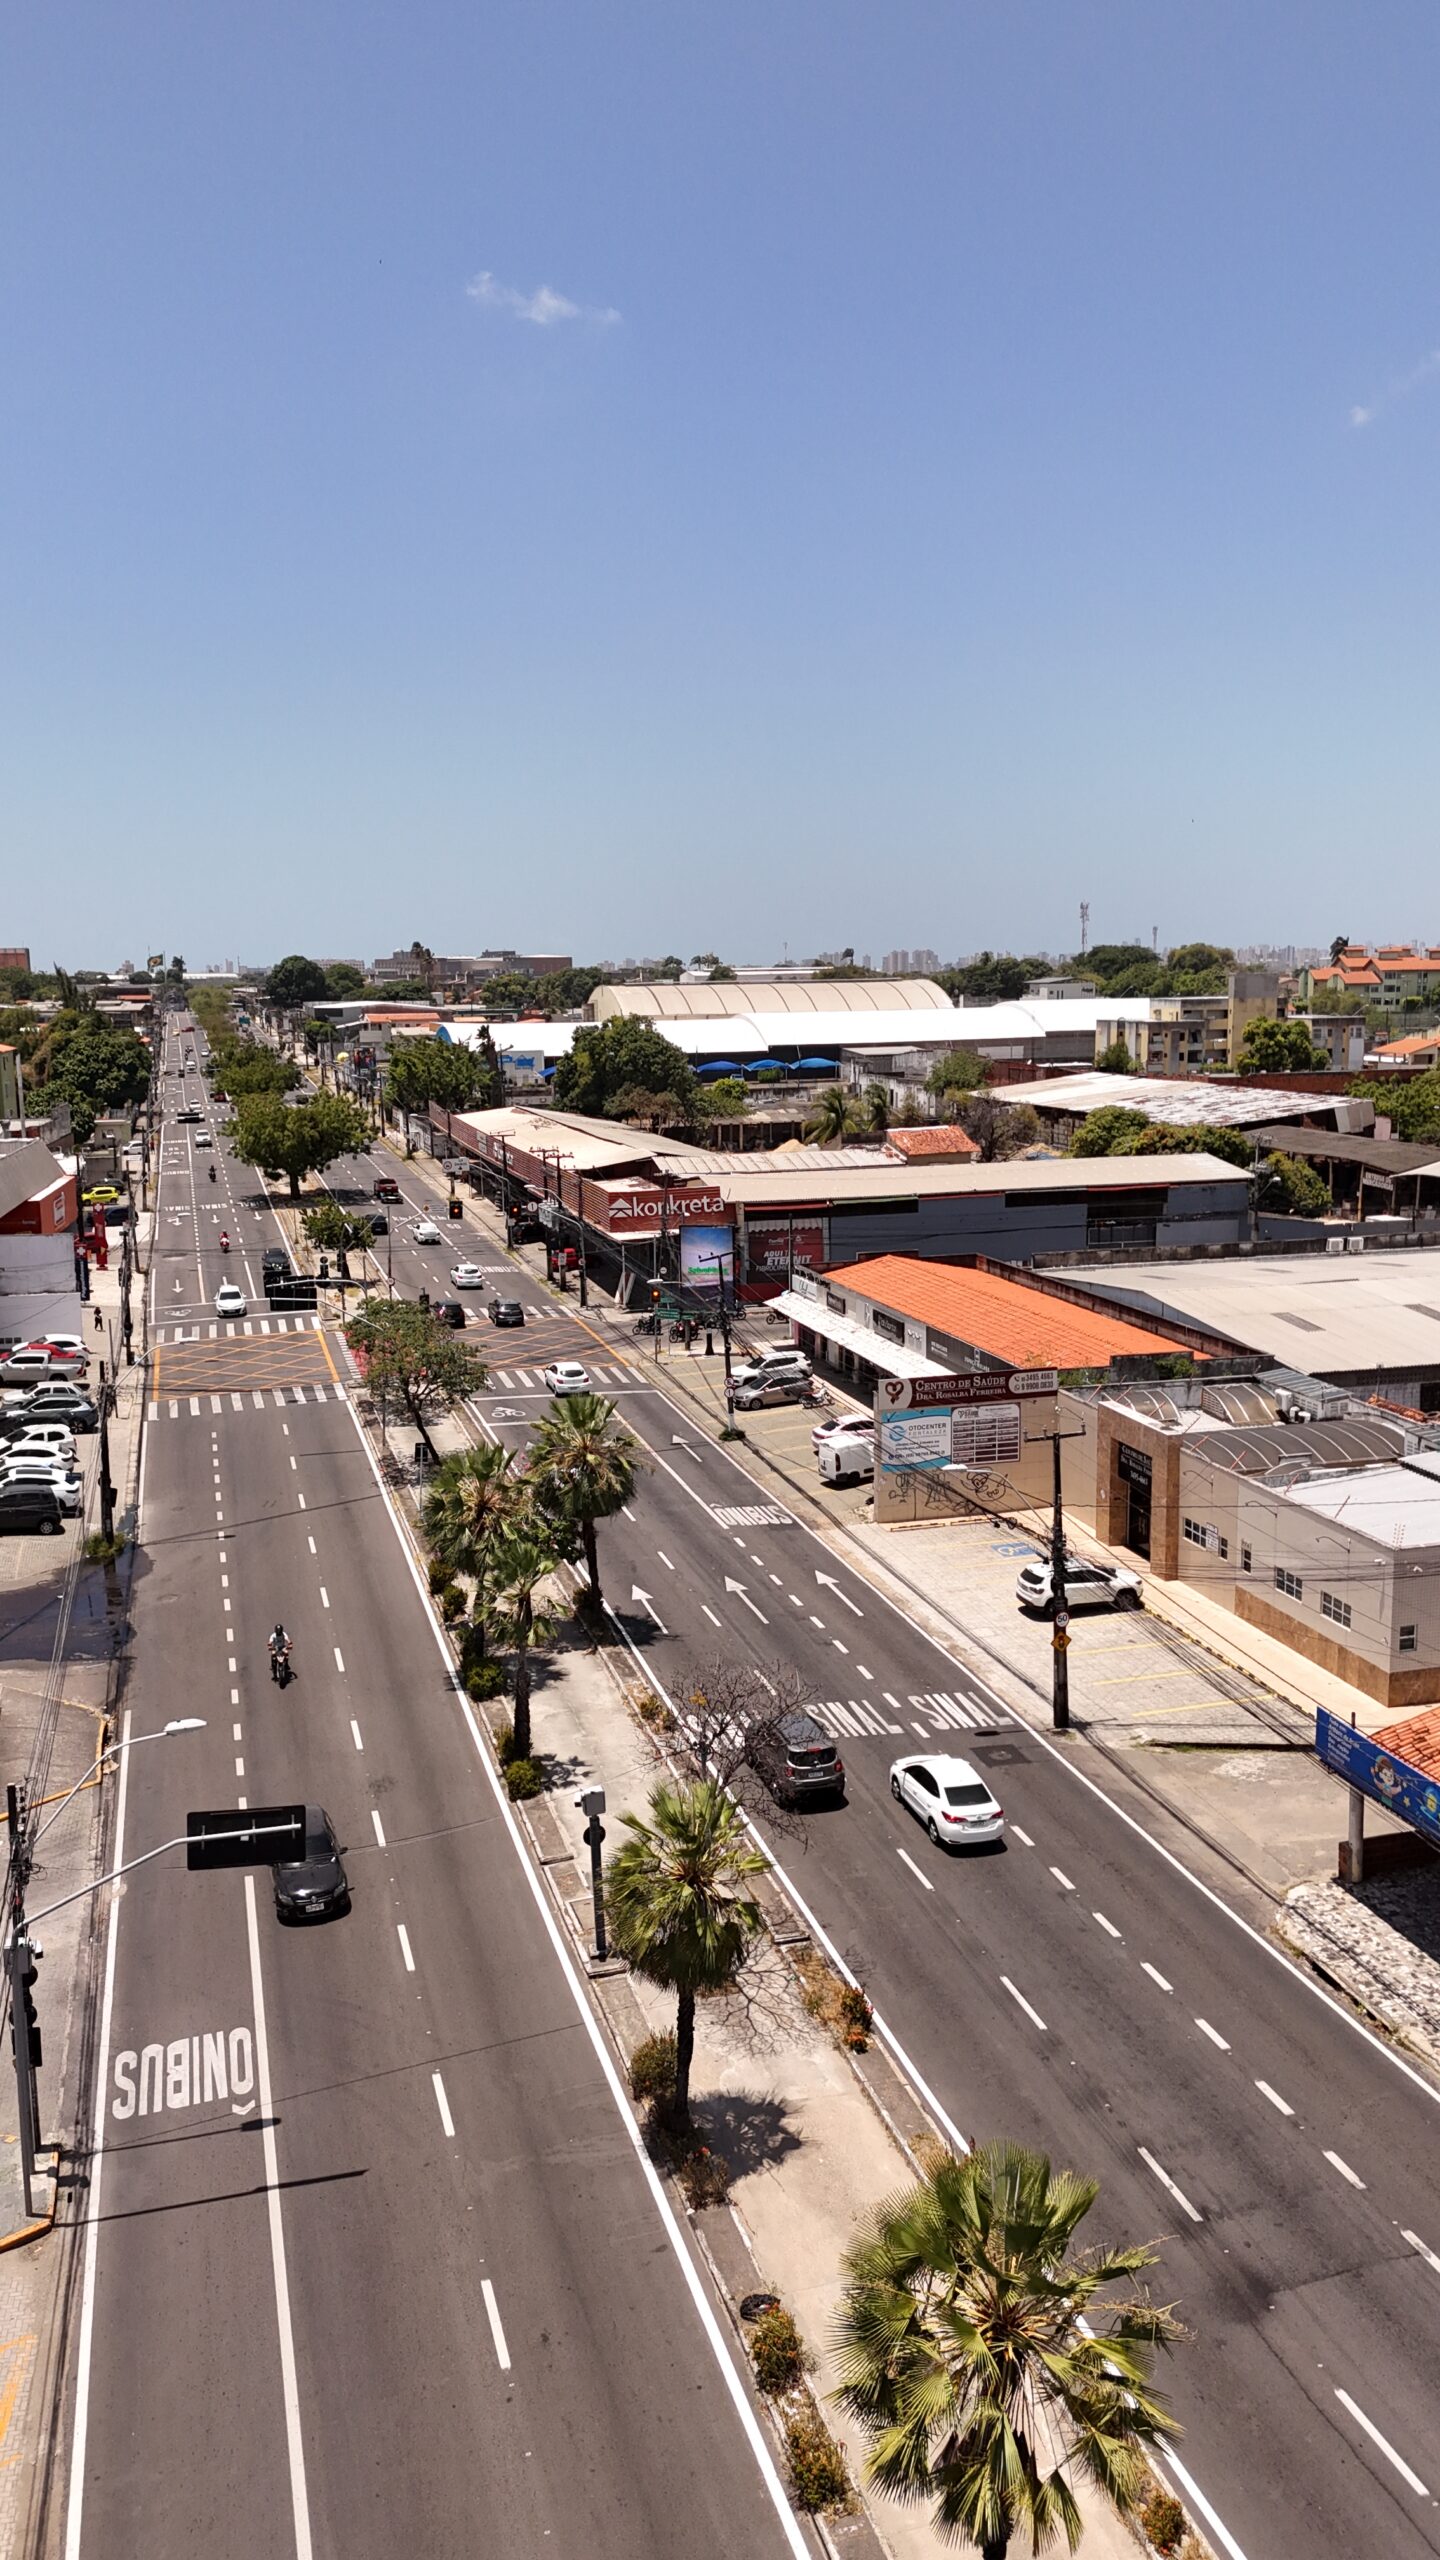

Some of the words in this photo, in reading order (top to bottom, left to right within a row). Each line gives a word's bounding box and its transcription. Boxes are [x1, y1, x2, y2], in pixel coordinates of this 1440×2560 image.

[633, 1194, 724, 1217] konkreta
[908, 1422, 947, 1431] OTOCENTER
[710, 1503, 793, 1526] ÔNIBUS
[1057, 1614, 1067, 1622] 50
[802, 1699, 904, 1739] SINAL
[907, 1692, 1015, 1731] SINAL
[112, 2026, 256, 2120] ÔNIBUS
